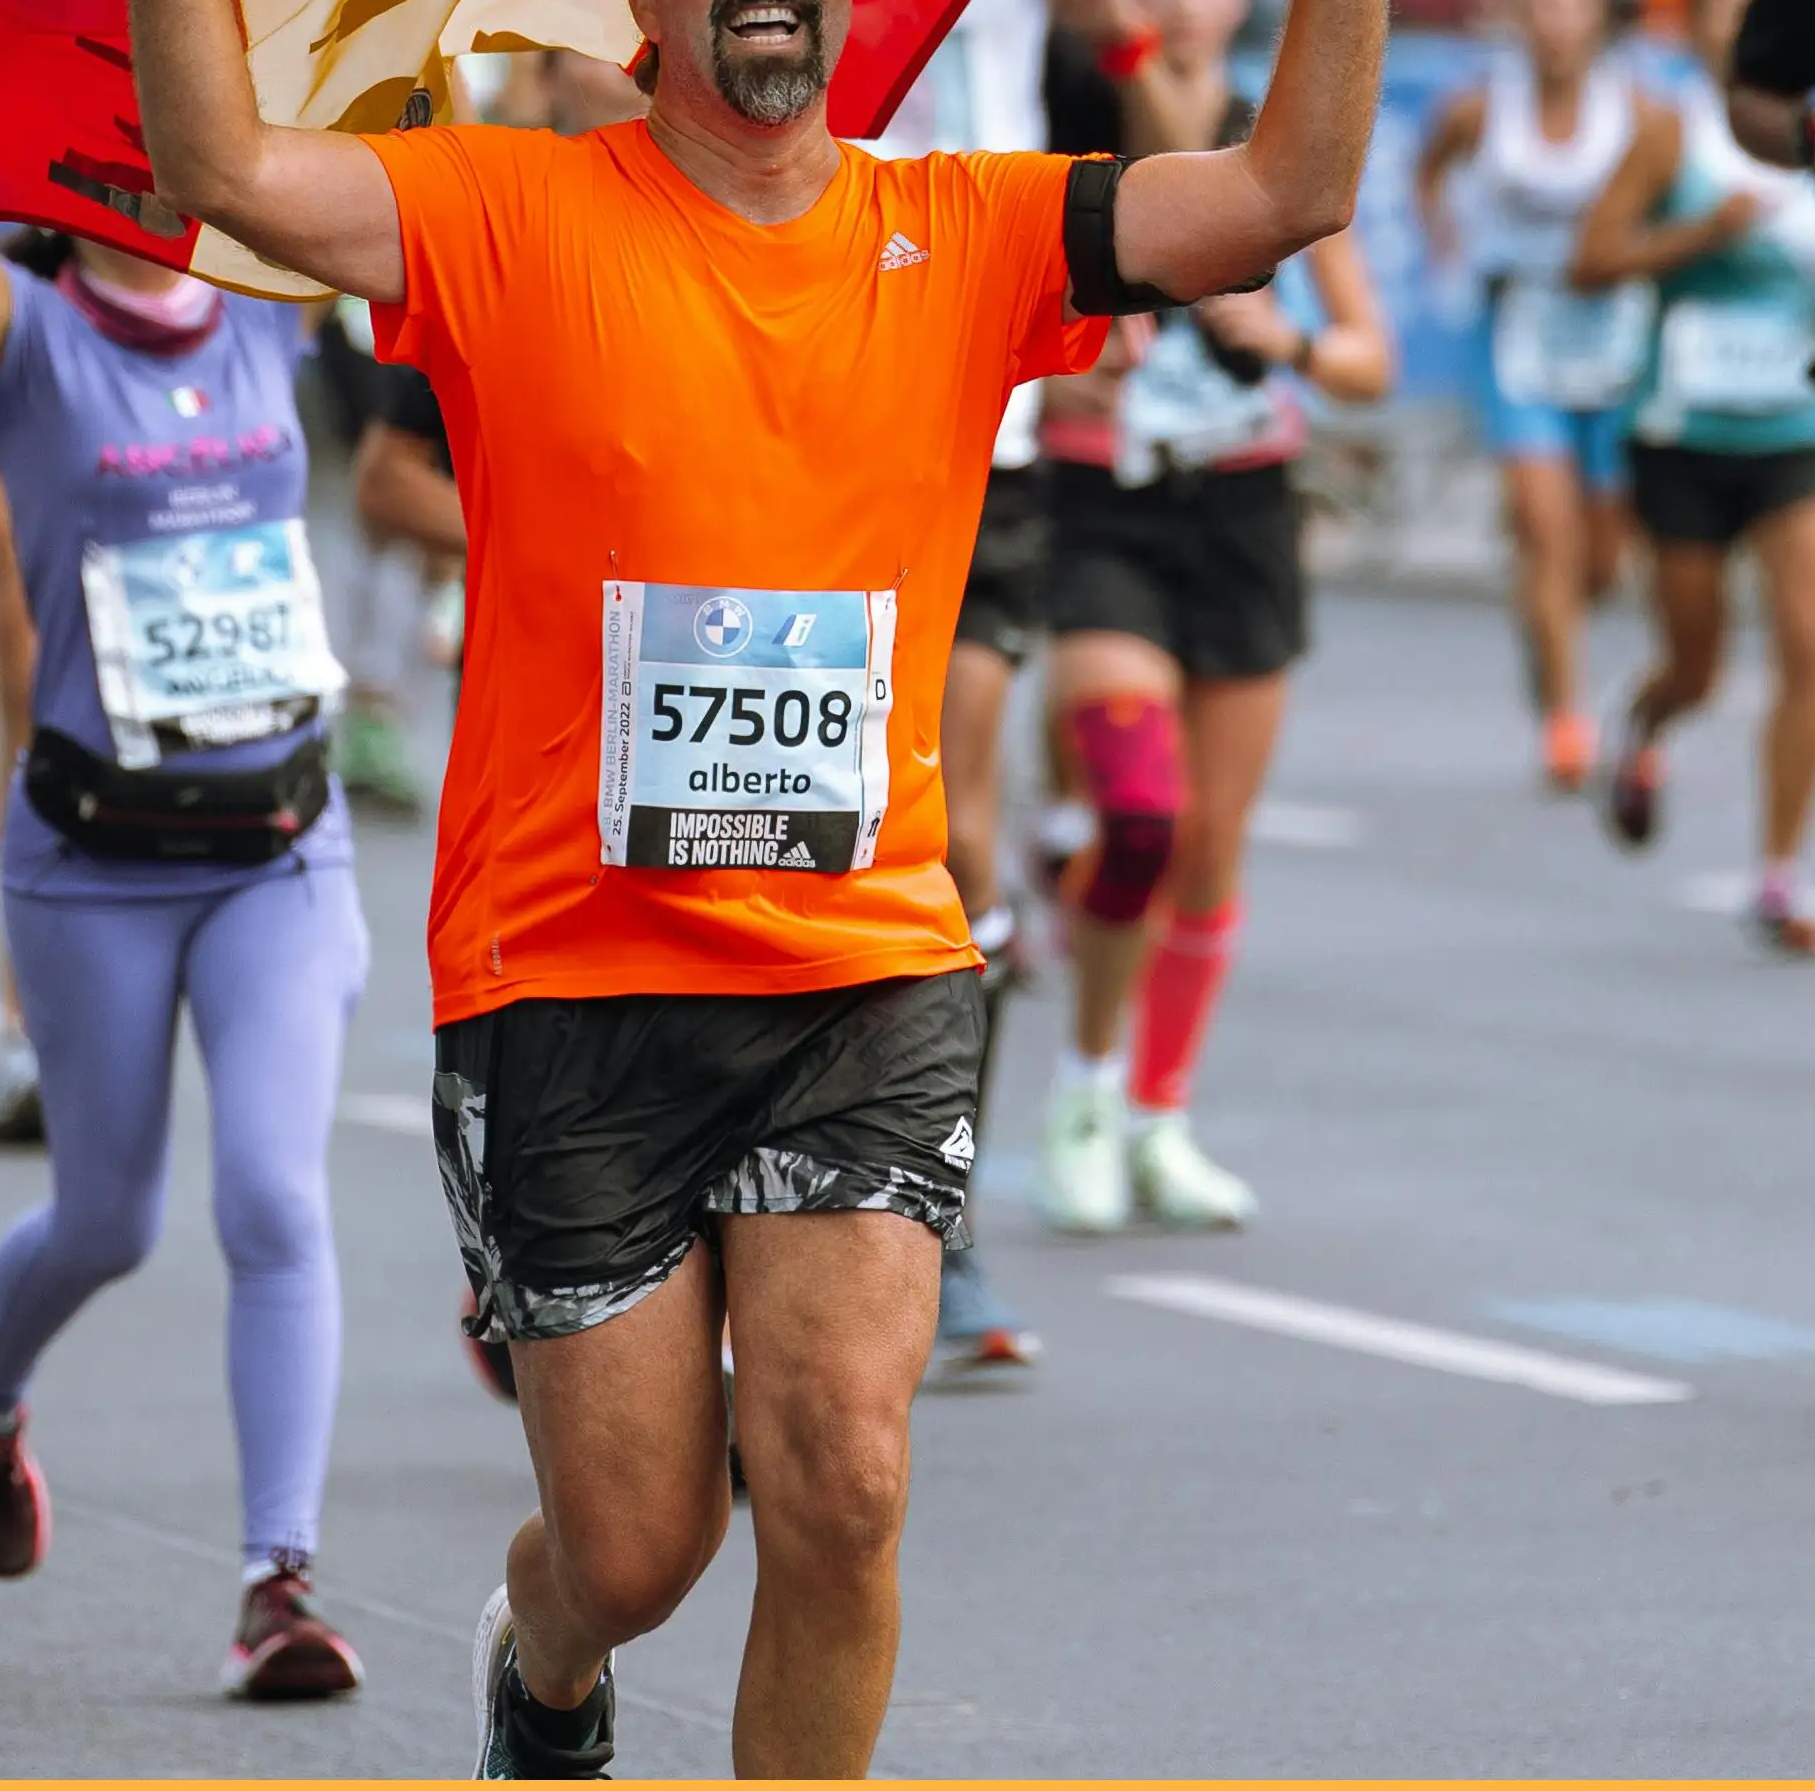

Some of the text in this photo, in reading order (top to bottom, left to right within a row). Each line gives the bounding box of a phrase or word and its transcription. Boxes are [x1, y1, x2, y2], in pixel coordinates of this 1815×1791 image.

[877, 249, 930, 271] adidas
[604, 610, 622, 766] BERLIN-MARATHON
[875, 679, 886, 700] D
[651, 684, 852, 748] 57508
[612, 702, 631, 836] 25. September 2022
[689, 762, 812, 794] alberto
[602, 769, 617, 808] BMW
[669, 811, 790, 840] IMPOSSIBLE
[667, 838, 816, 869] IS NOTHING adidas
